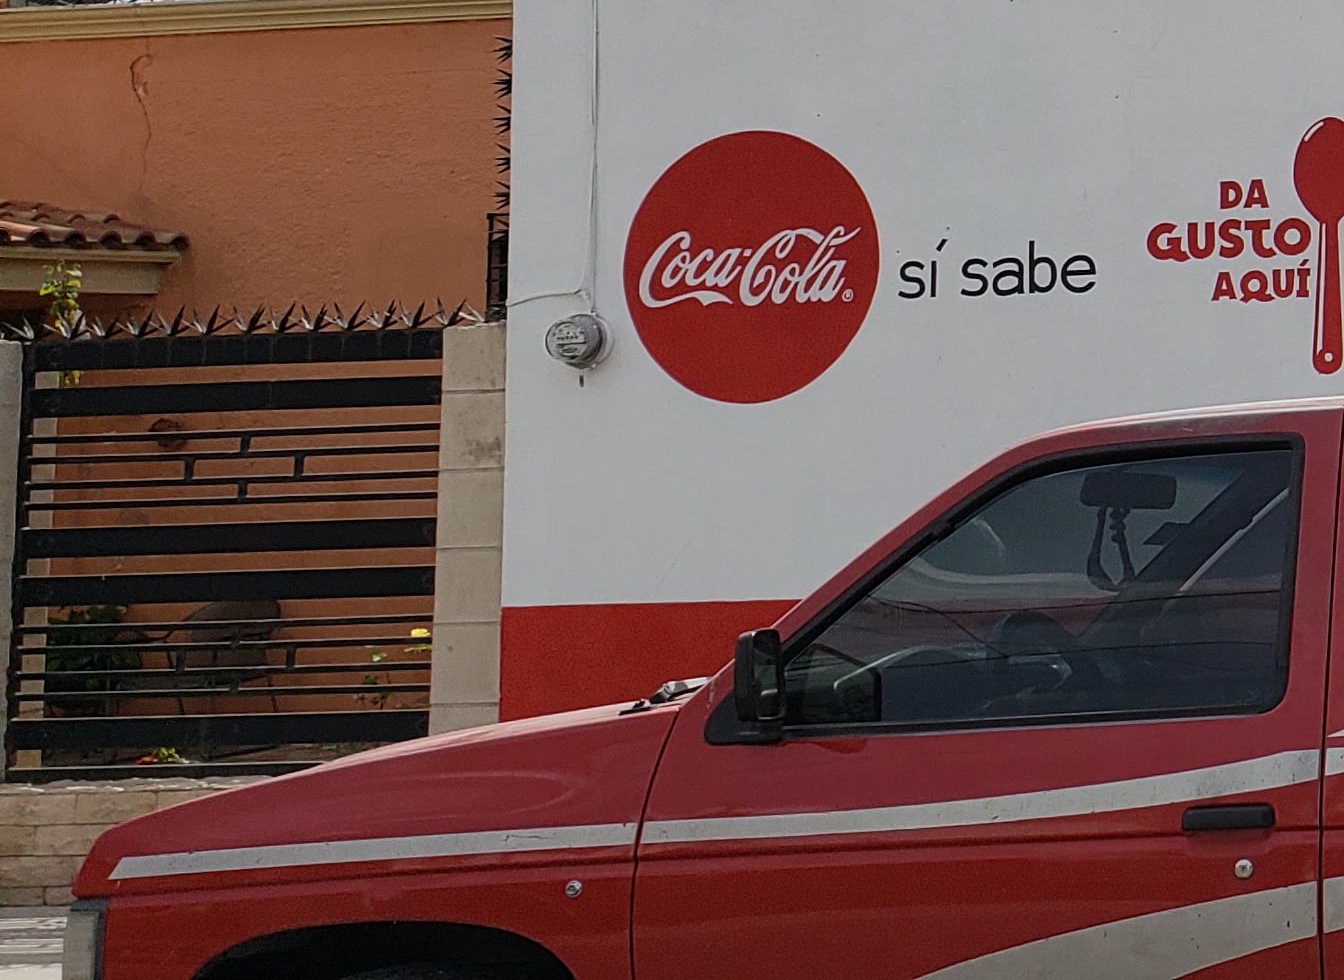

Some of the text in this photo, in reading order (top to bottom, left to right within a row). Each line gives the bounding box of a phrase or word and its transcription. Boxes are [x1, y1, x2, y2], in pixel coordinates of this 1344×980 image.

[1219, 178, 1270, 210] DA
[1146, 217, 1312, 262] GUSTO
[639, 226, 1097, 308] Coca-Cola sí sabe
[1211, 258, 1312, 303] AQUÍ
